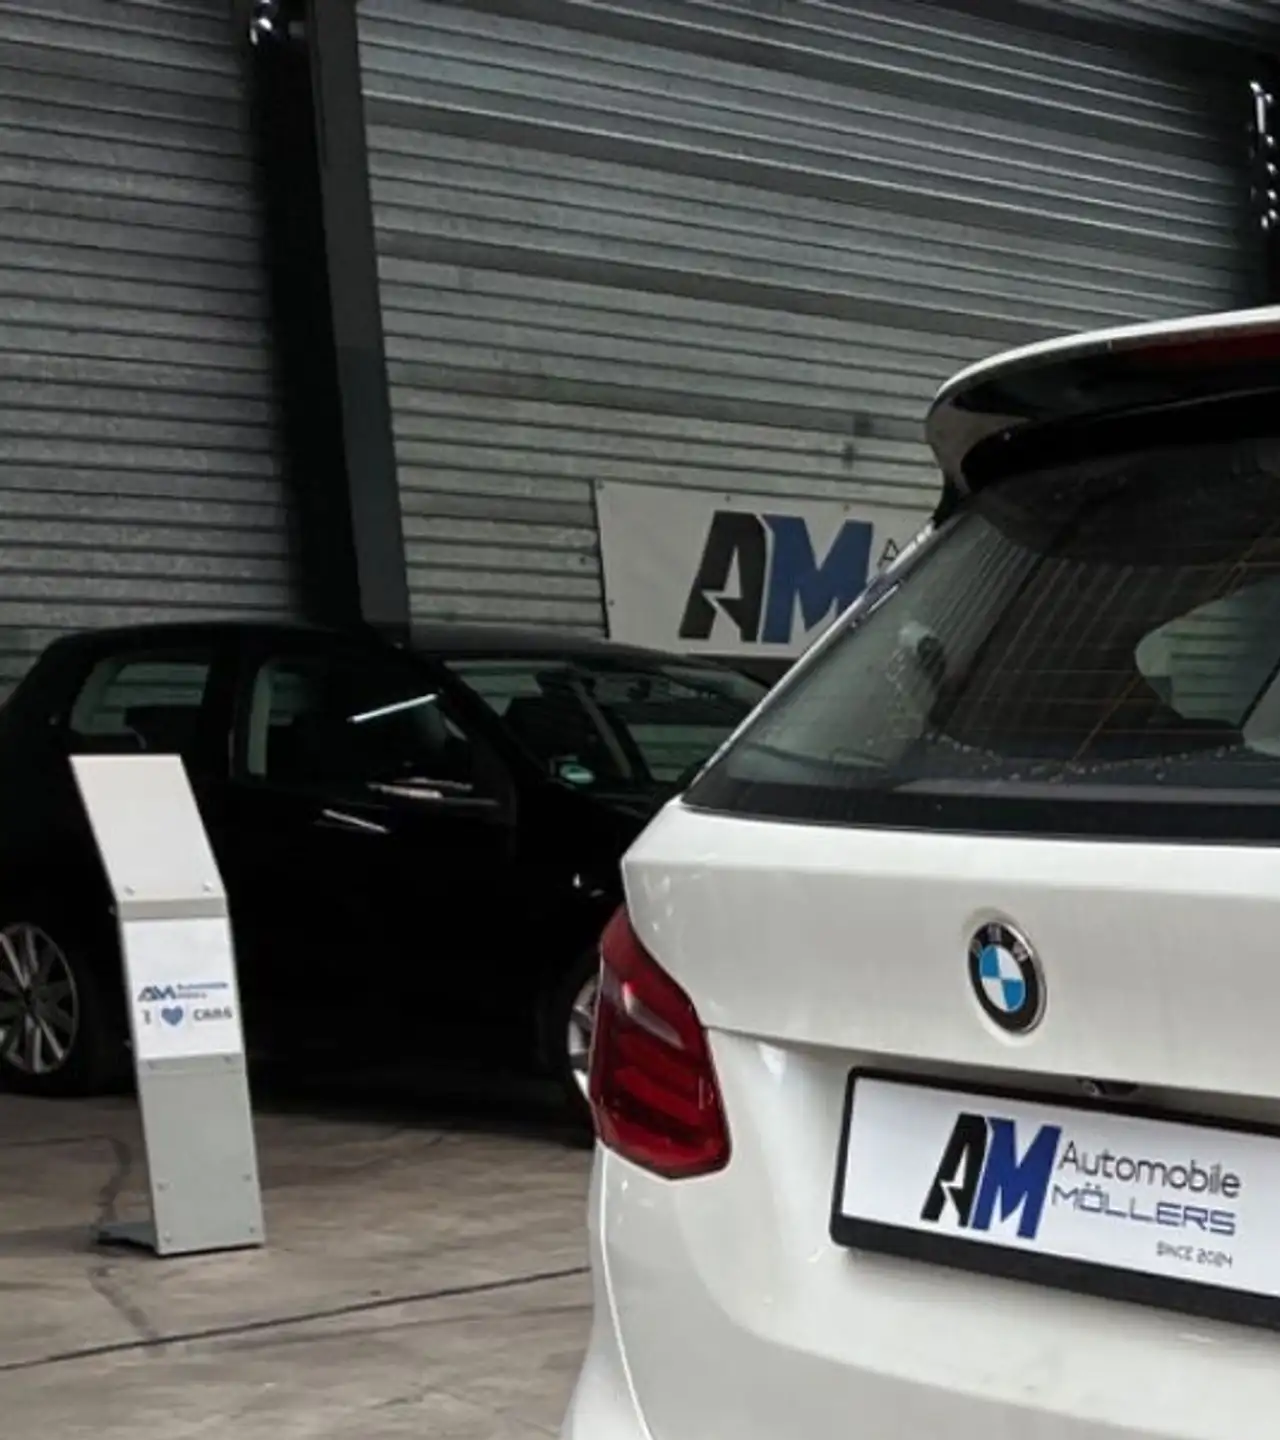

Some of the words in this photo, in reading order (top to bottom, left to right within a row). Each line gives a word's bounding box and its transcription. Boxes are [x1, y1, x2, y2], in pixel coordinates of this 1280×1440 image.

[678, 510, 873, 643] AM
[920, 1111, 1062, 1240] AM
[1051, 1182, 1236, 1237] MÖLLERS
[1059, 1140, 1241, 1199] Automobile
